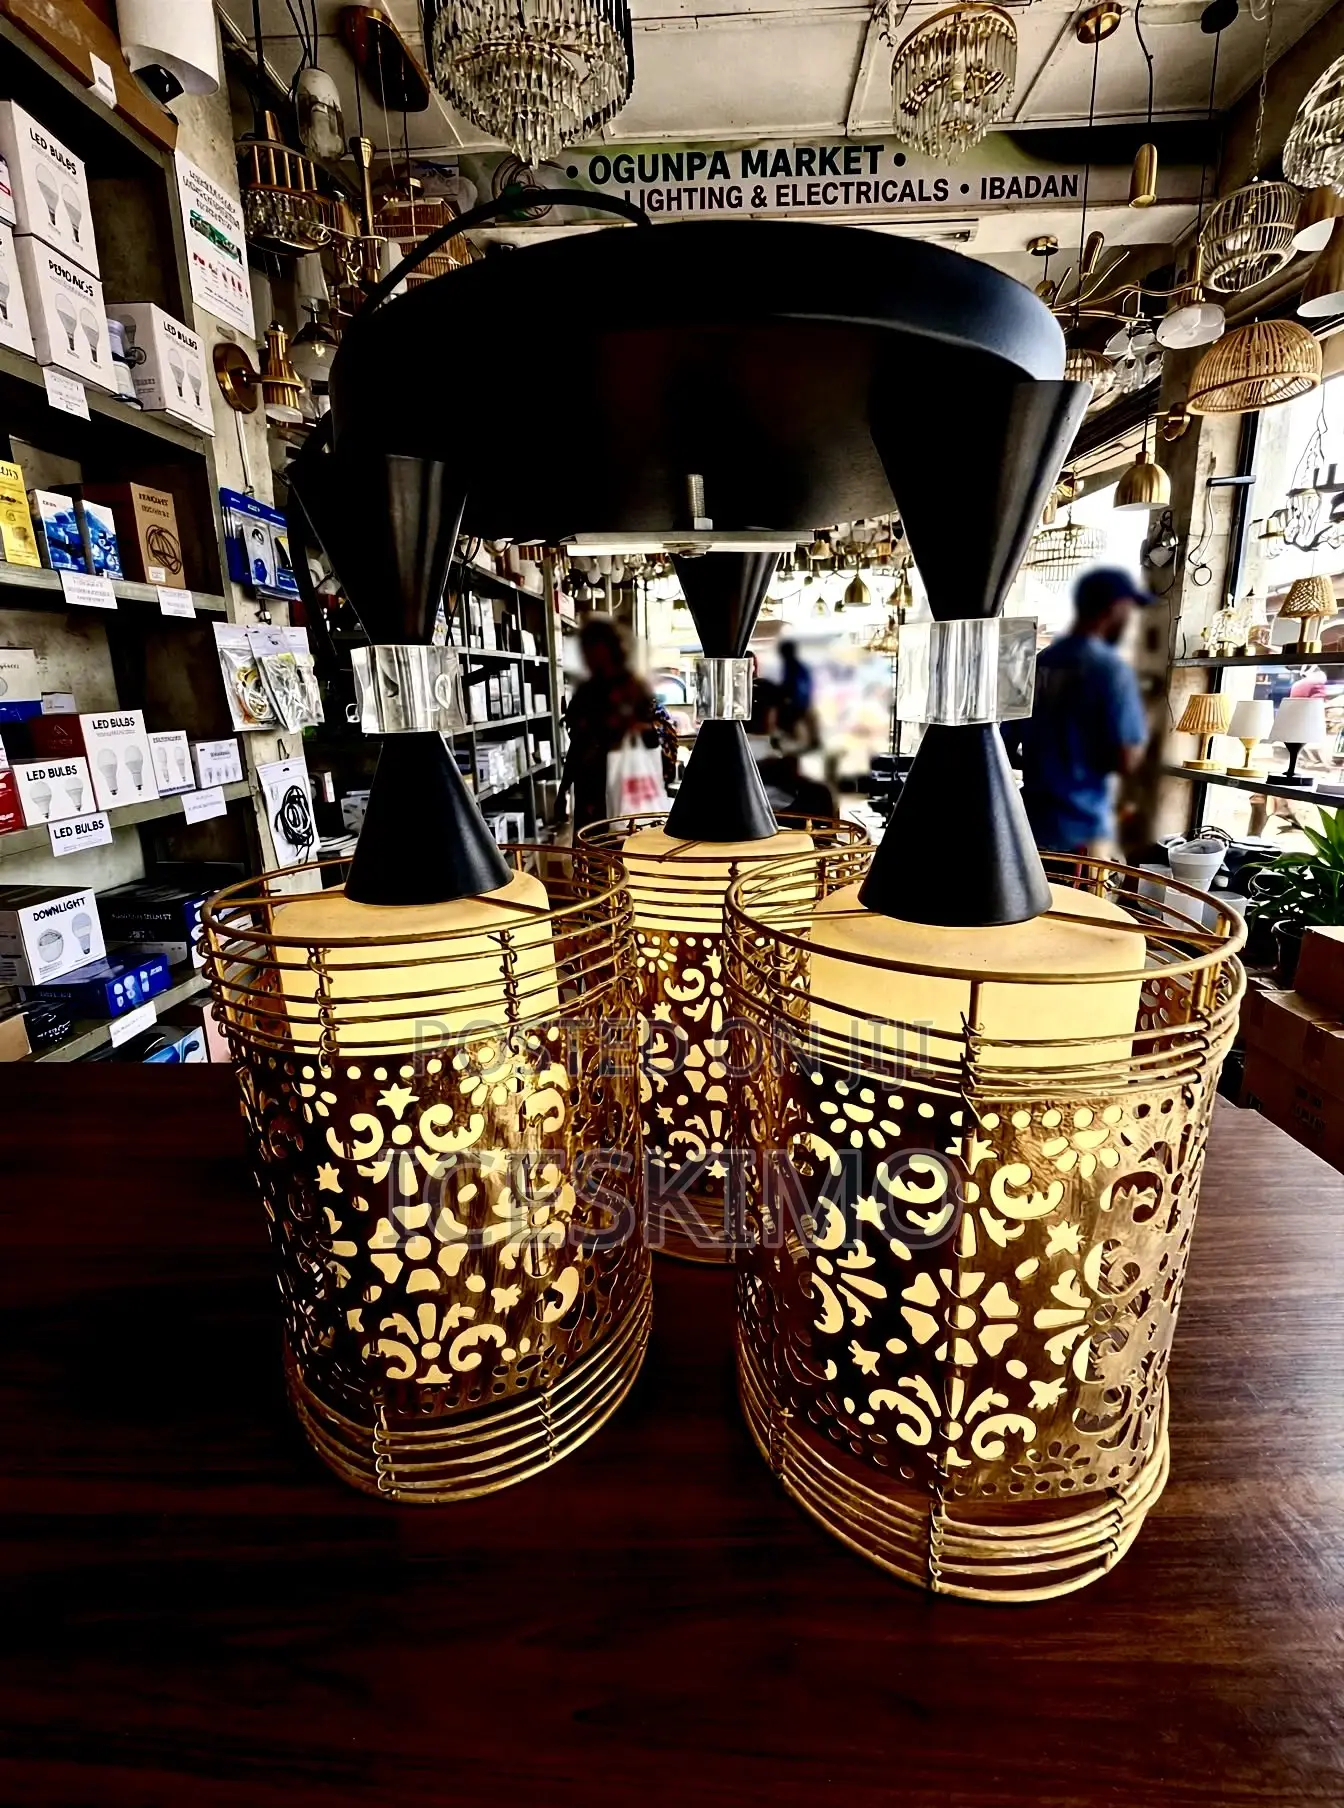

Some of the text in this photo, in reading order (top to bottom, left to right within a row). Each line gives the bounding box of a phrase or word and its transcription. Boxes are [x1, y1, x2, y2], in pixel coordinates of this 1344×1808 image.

[30, 127, 48, 150] LED
[588, 145, 884, 185] OGUNPA MARKET
[751, 185, 768, 208] &
[776, 178, 948, 207] ELECTRICALS
[980, 174, 1078, 200] IBADAN
[163, 321, 177, 336] LED
[92, 717, 135, 730] LED BULBS
[26, 765, 78, 781] LED BULBS
[53, 819, 105, 839] LED BULBS
[33, 896, 86, 922] DOWNLIGHT
